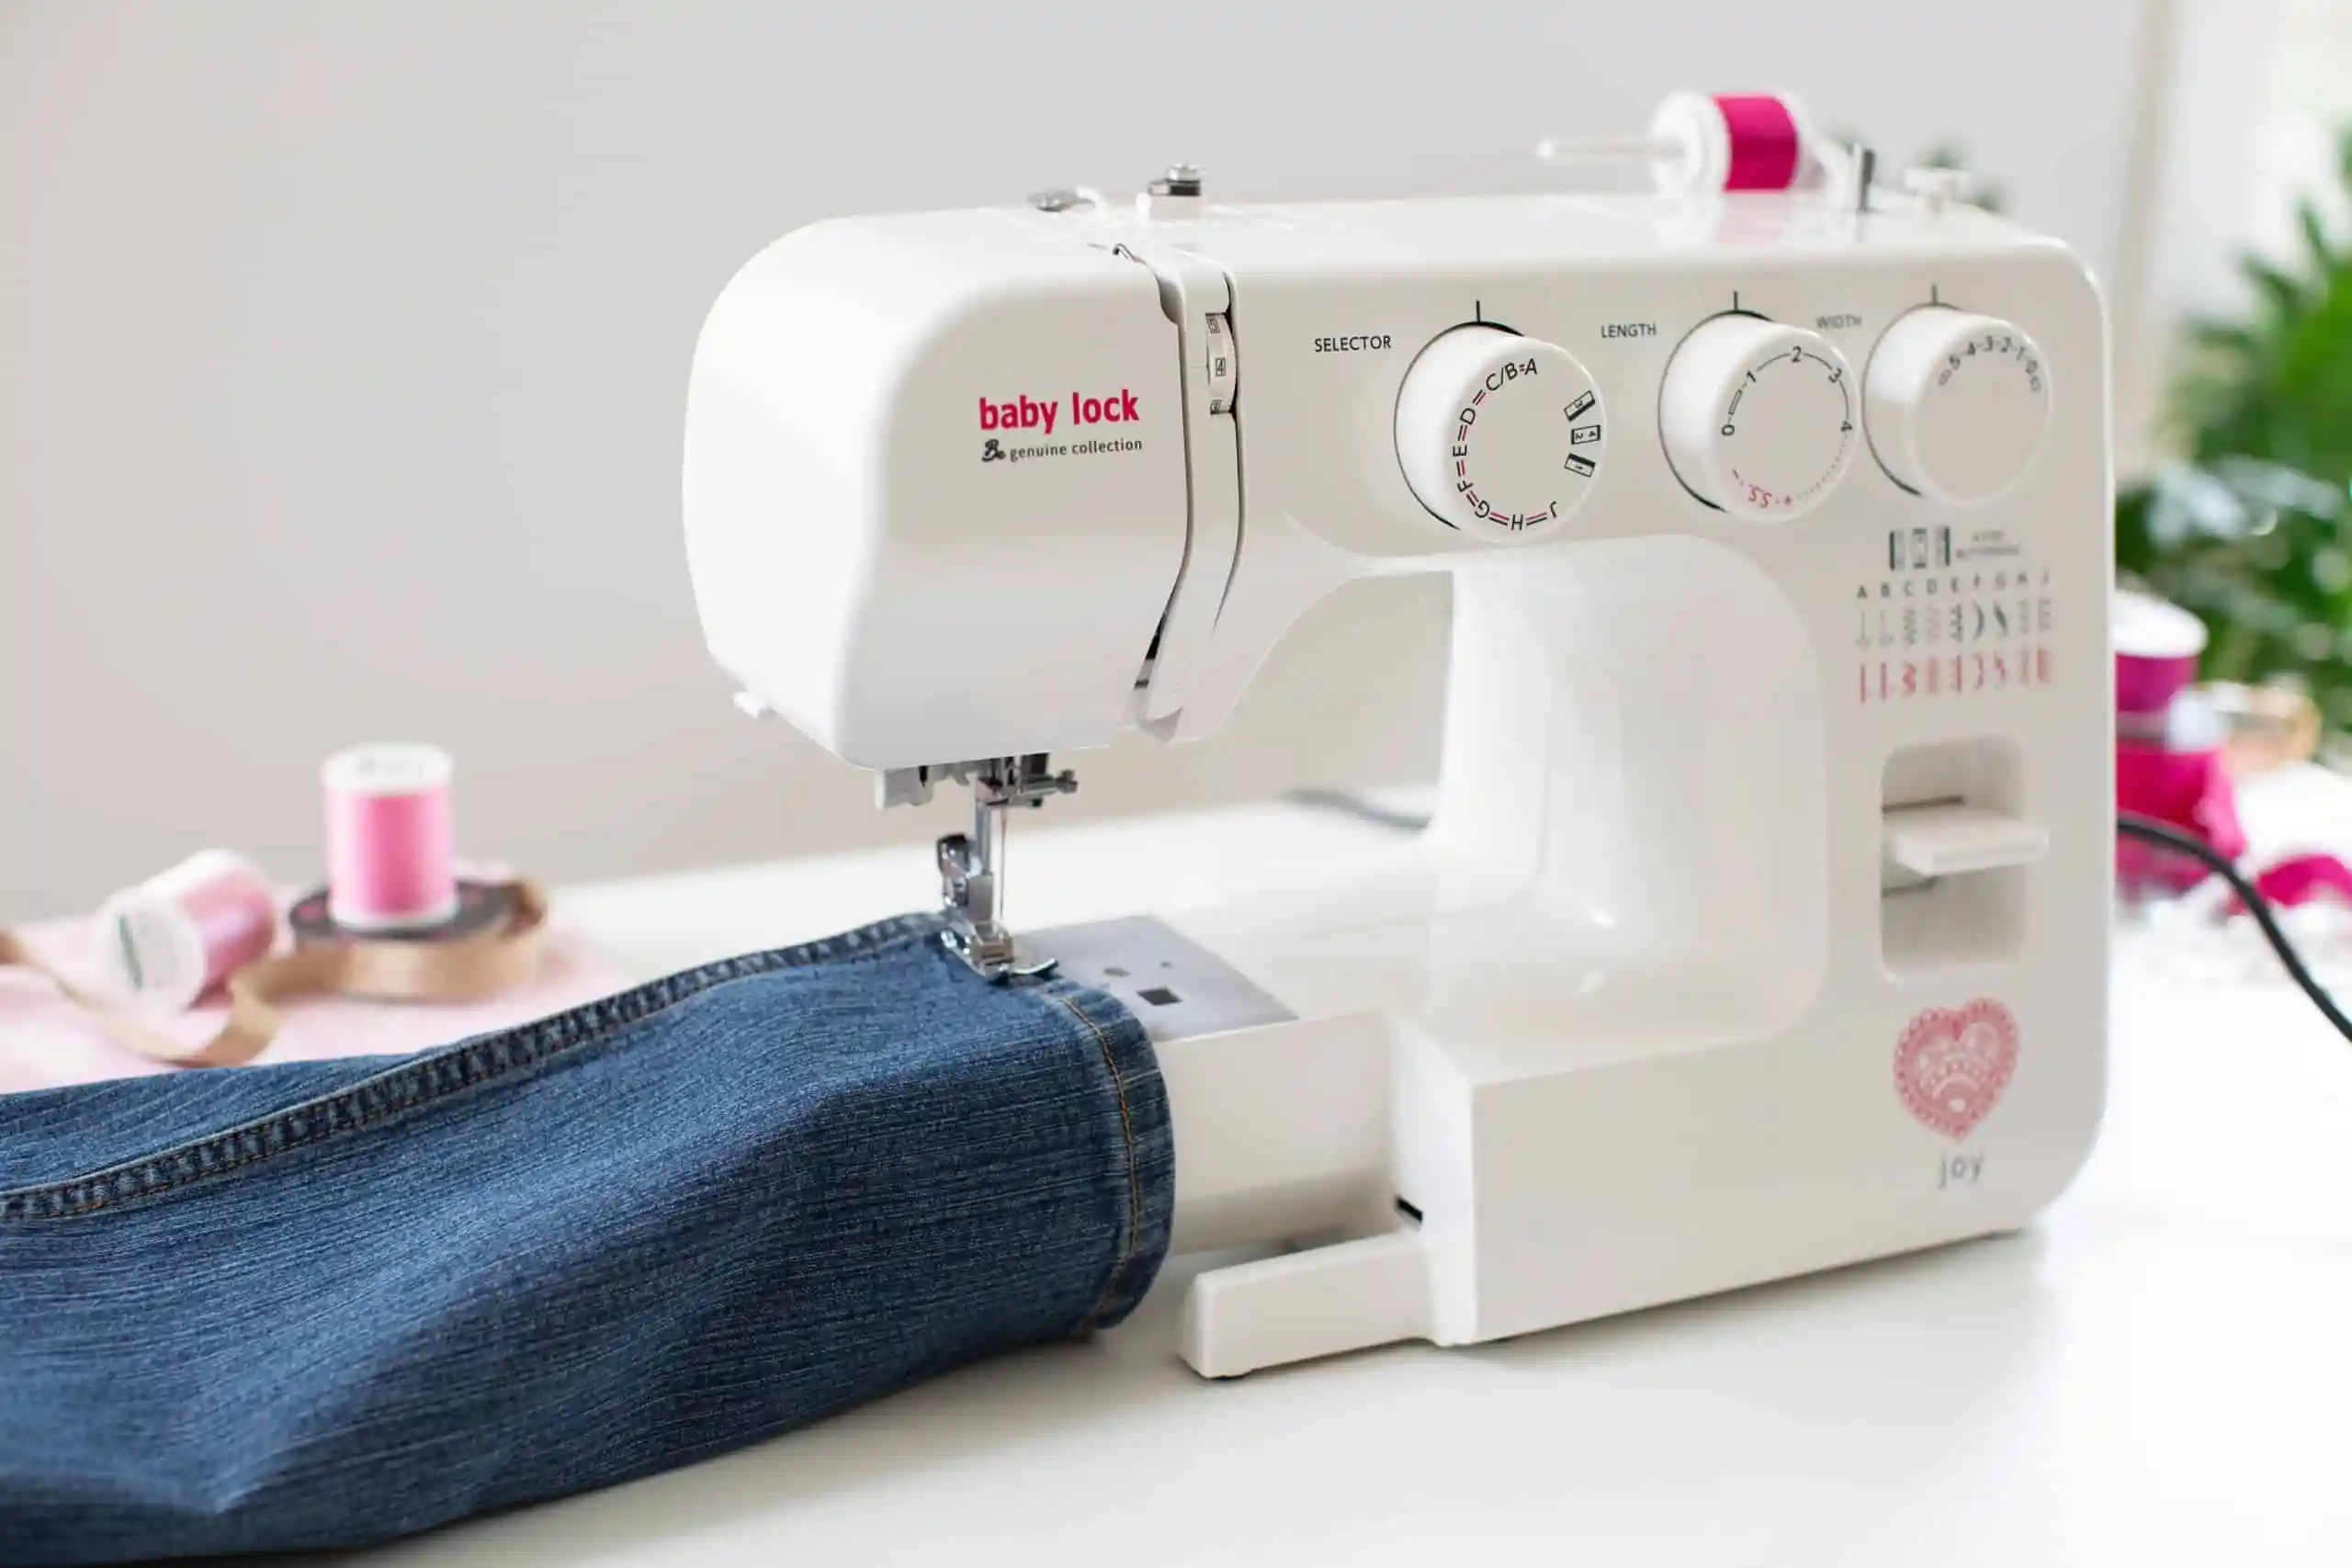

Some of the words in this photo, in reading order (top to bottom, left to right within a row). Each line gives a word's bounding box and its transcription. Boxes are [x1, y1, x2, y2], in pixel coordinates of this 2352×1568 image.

[1601, 322, 1657, 338] LENGTH
[1815, 314, 1861, 329] WIDTH
[1315, 335, 1392, 353] SELECTOR
[1721, 423, 1736, 436] 0
[1746, 370, 1757, 383] 1
[1791, 345, 1802, 363] 2
[1827, 367, 1842, 384] 3
[1840, 420, 1853, 433] 4
[979, 394, 1058, 434] baby
[1072, 389, 1140, 425] lock
[1459, 407, 1476, 425] D
[1010, 446, 1068, 462] genuine
[1071, 437, 1142, 456] collection
[1452, 445, 1468, 457] E
[1456, 479, 1474, 492] F
[1474, 500, 1491, 518] G
[1510, 513, 1524, 531] H
[1938, 1150, 1984, 1190] joy
